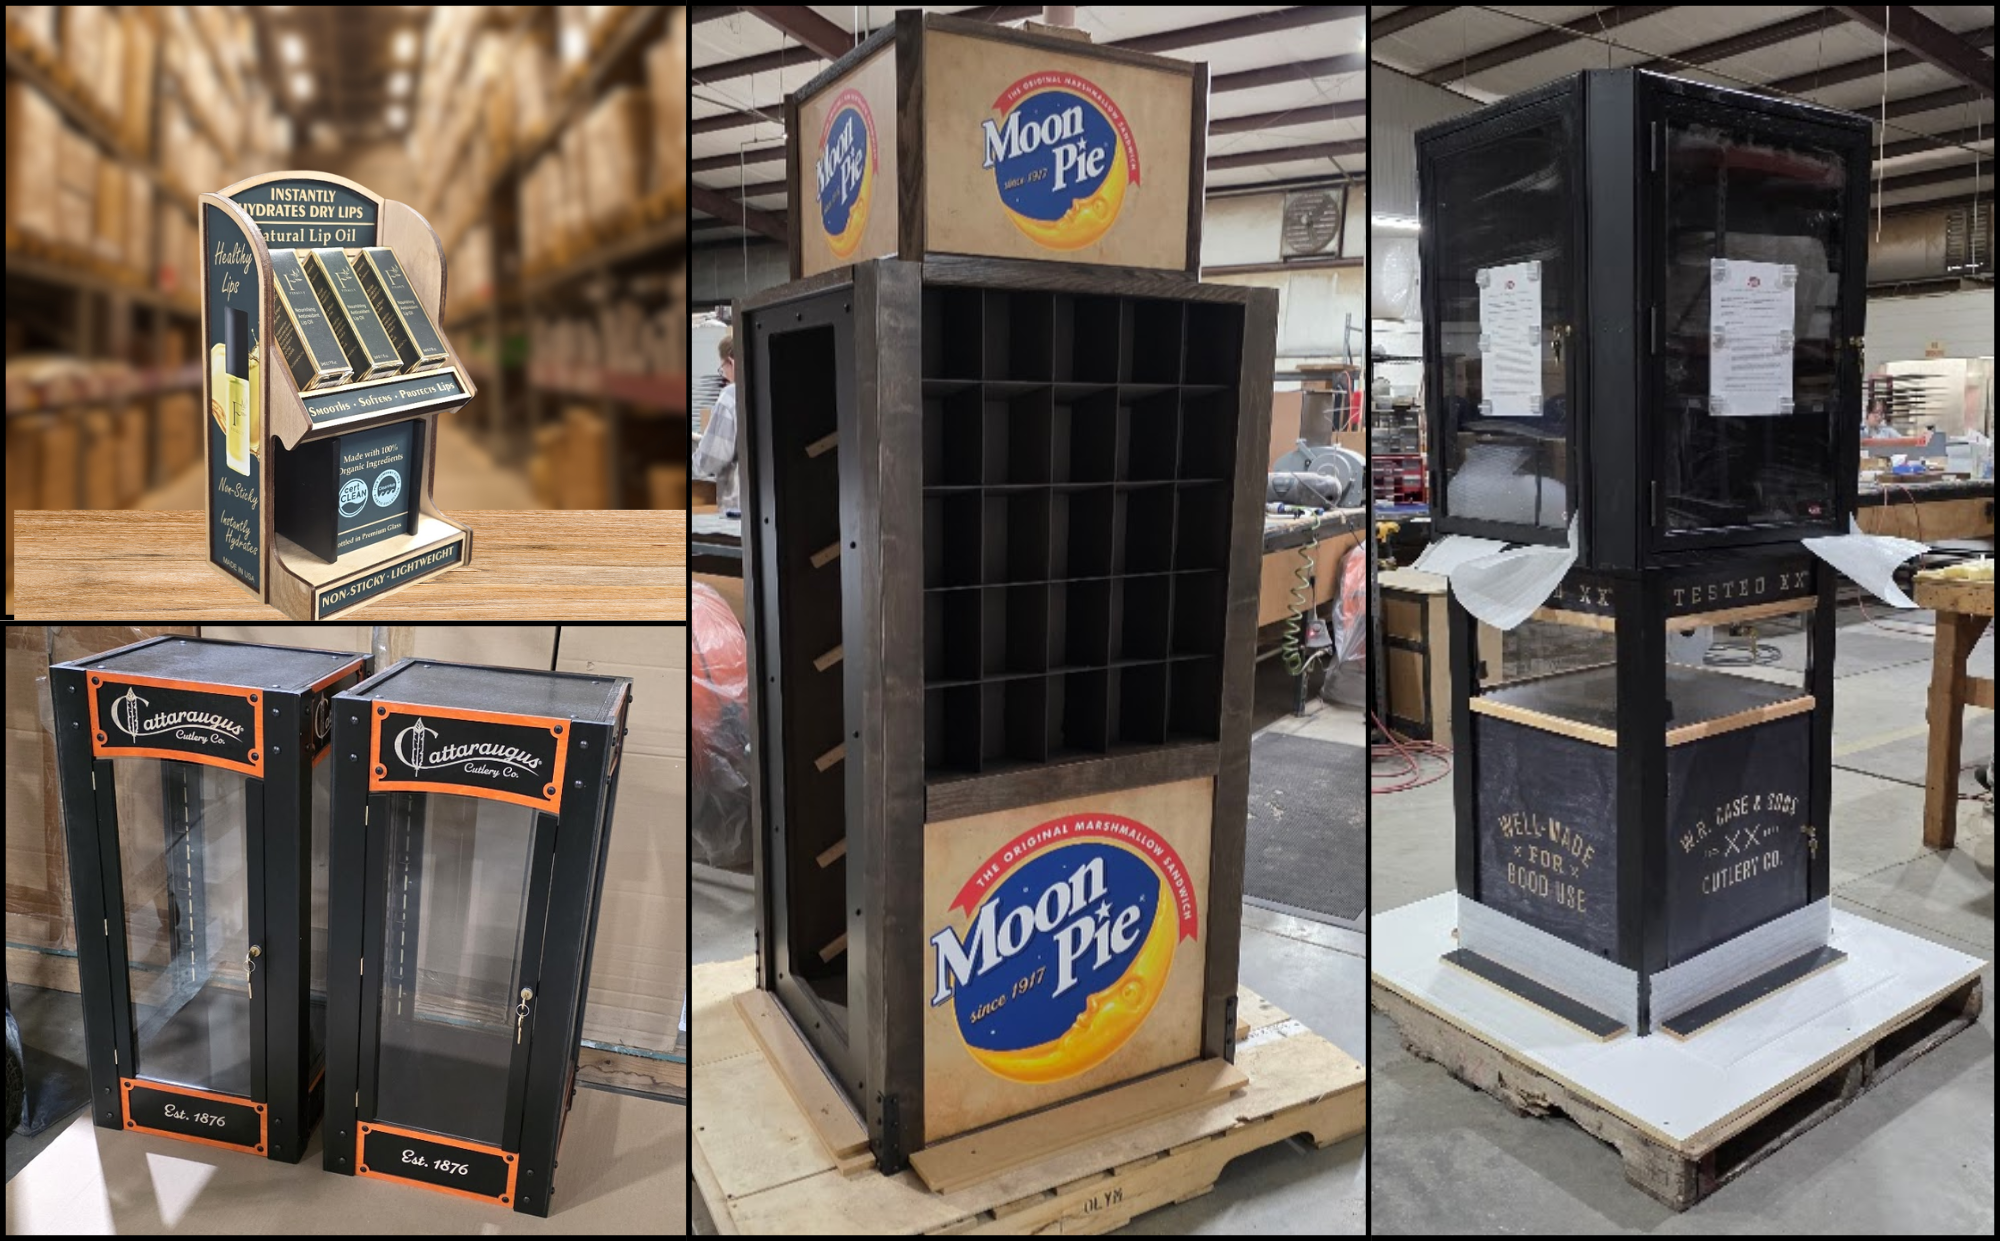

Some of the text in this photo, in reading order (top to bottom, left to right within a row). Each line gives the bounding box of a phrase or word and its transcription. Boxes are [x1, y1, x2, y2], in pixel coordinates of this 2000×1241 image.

[982, 105, 1084, 168] Moon
[816, 116, 854, 202] Moon
[1052, 138, 1105, 192] Pie
[841, 147, 863, 205] Pie
[270, 187, 336, 203] INSTANTLY
[310, 205, 335, 218] DRY
[338, 206, 363, 219] LIPS
[259, 228, 356, 246] atural Lip Oil
[214, 240, 253, 275] Healthy
[222, 271, 240, 302] Lips
[436, 382, 455, 393] Lips
[339, 454, 403, 476] Organic Ingredients
[343, 443, 398, 463] Made with 100%
[218, 476, 259, 511] Non-Sticky
[340, 488, 367, 503] CLEAN
[344, 483, 360, 494] cert
[220, 509, 251, 541] Instantly
[337, 537, 354, 548] ottled
[362, 527, 386, 540] Premium
[387, 522, 402, 531] Glass
[225, 527, 259, 556] Hydrates
[222, 556, 255, 583] MADE IN USA
[321, 546, 455, 608] NON-STICKY LIGHTWEIGHT
[1674, 576, 1766, 607] TESTED
[111, 687, 243, 744] Cattaraugus
[175, 729, 225, 745] Cutlery Co.
[394, 717, 541, 778] Cattaraugus
[464, 762, 519, 778] Cutlery Co.
[1498, 811, 1595, 869] WELL-MADE
[976, 820, 1192, 920] THE ORIGINAL MARSHMALLOW SANDWICH
[1529, 844, 1564, 875] FOR
[1508, 861, 1587, 913] GOOD USE
[1702, 856, 1759, 895] CUTLERY
[931, 856, 1108, 1007] Moon
[1051, 901, 1141, 999] Pie
[969, 965, 1047, 1024] since 1917
[164, 1103, 226, 1127] Est. 1876
[401, 1149, 469, 1176] Est. 1876
